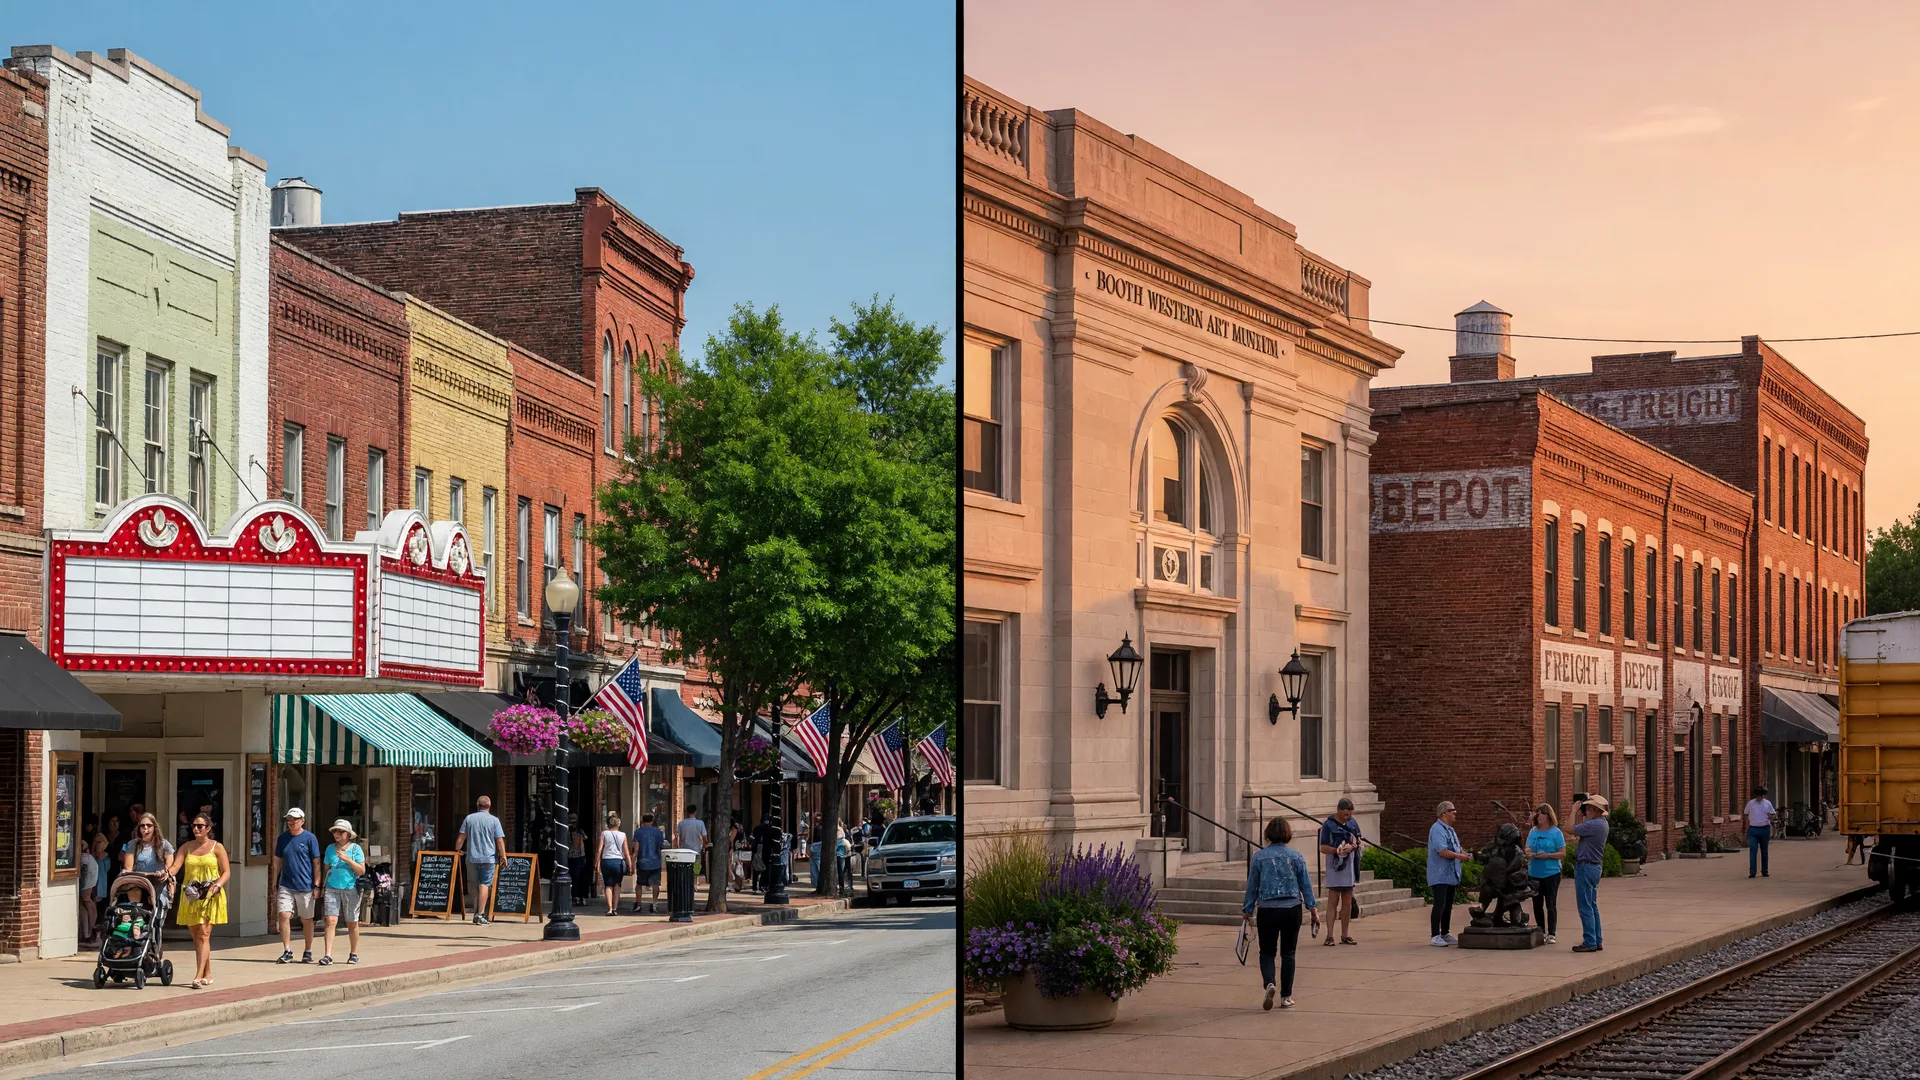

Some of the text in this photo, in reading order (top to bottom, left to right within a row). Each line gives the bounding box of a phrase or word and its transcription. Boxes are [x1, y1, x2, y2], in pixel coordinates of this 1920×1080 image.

[1096, 269, 1144, 306] BOOTH
[1147, 289, 1204, 330] WESTERN
[1206, 314, 1230, 339] ART
[1622, 388, 1740, 422] FREIGHT
[1369, 476, 1519, 525] BEPOT
[1544, 649, 1599, 685] FREIGHT
[1624, 660, 1660, 691] DEPOT
